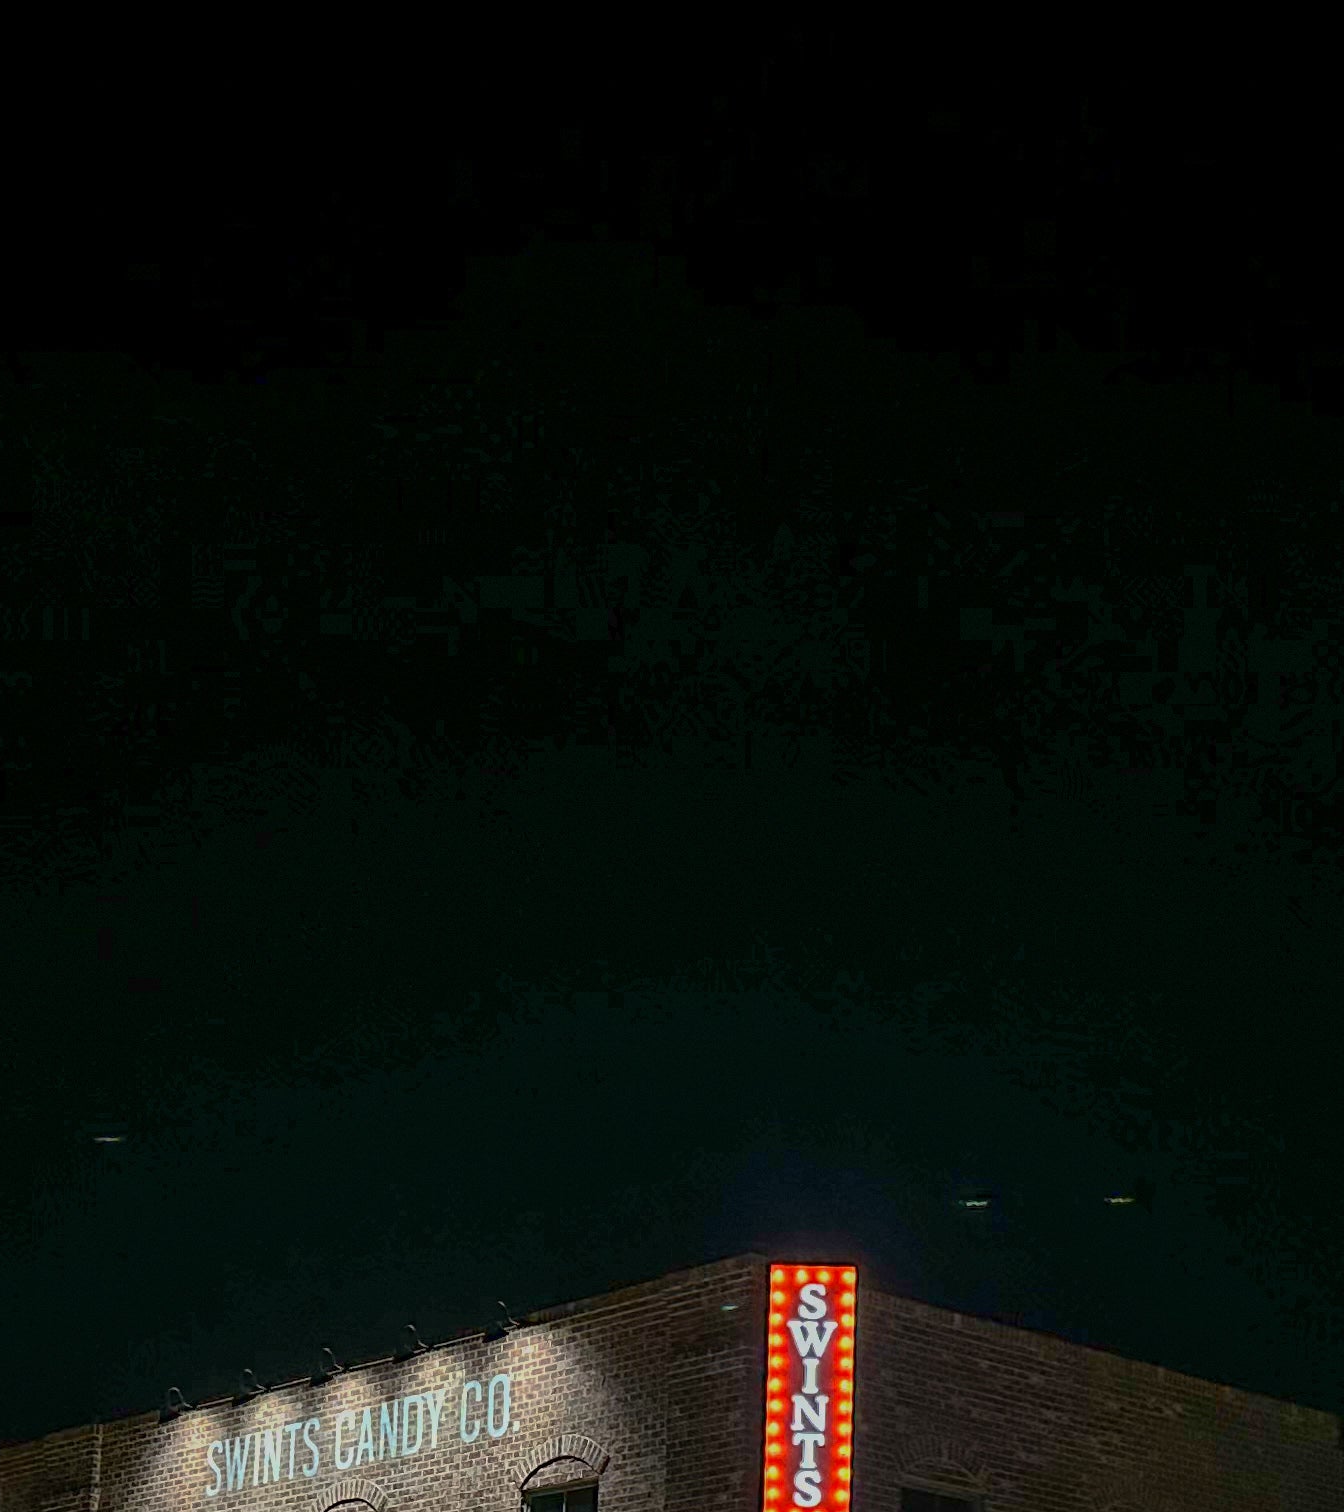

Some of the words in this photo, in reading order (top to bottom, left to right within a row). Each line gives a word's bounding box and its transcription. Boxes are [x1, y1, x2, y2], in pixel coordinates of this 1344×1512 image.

[205, 1417, 321, 1497] SWINTS
[334, 1388, 447, 1470] CANDY
[459, 1373, 521, 1443] CO.
[787, 1283, 839, 1508] SWINTS
